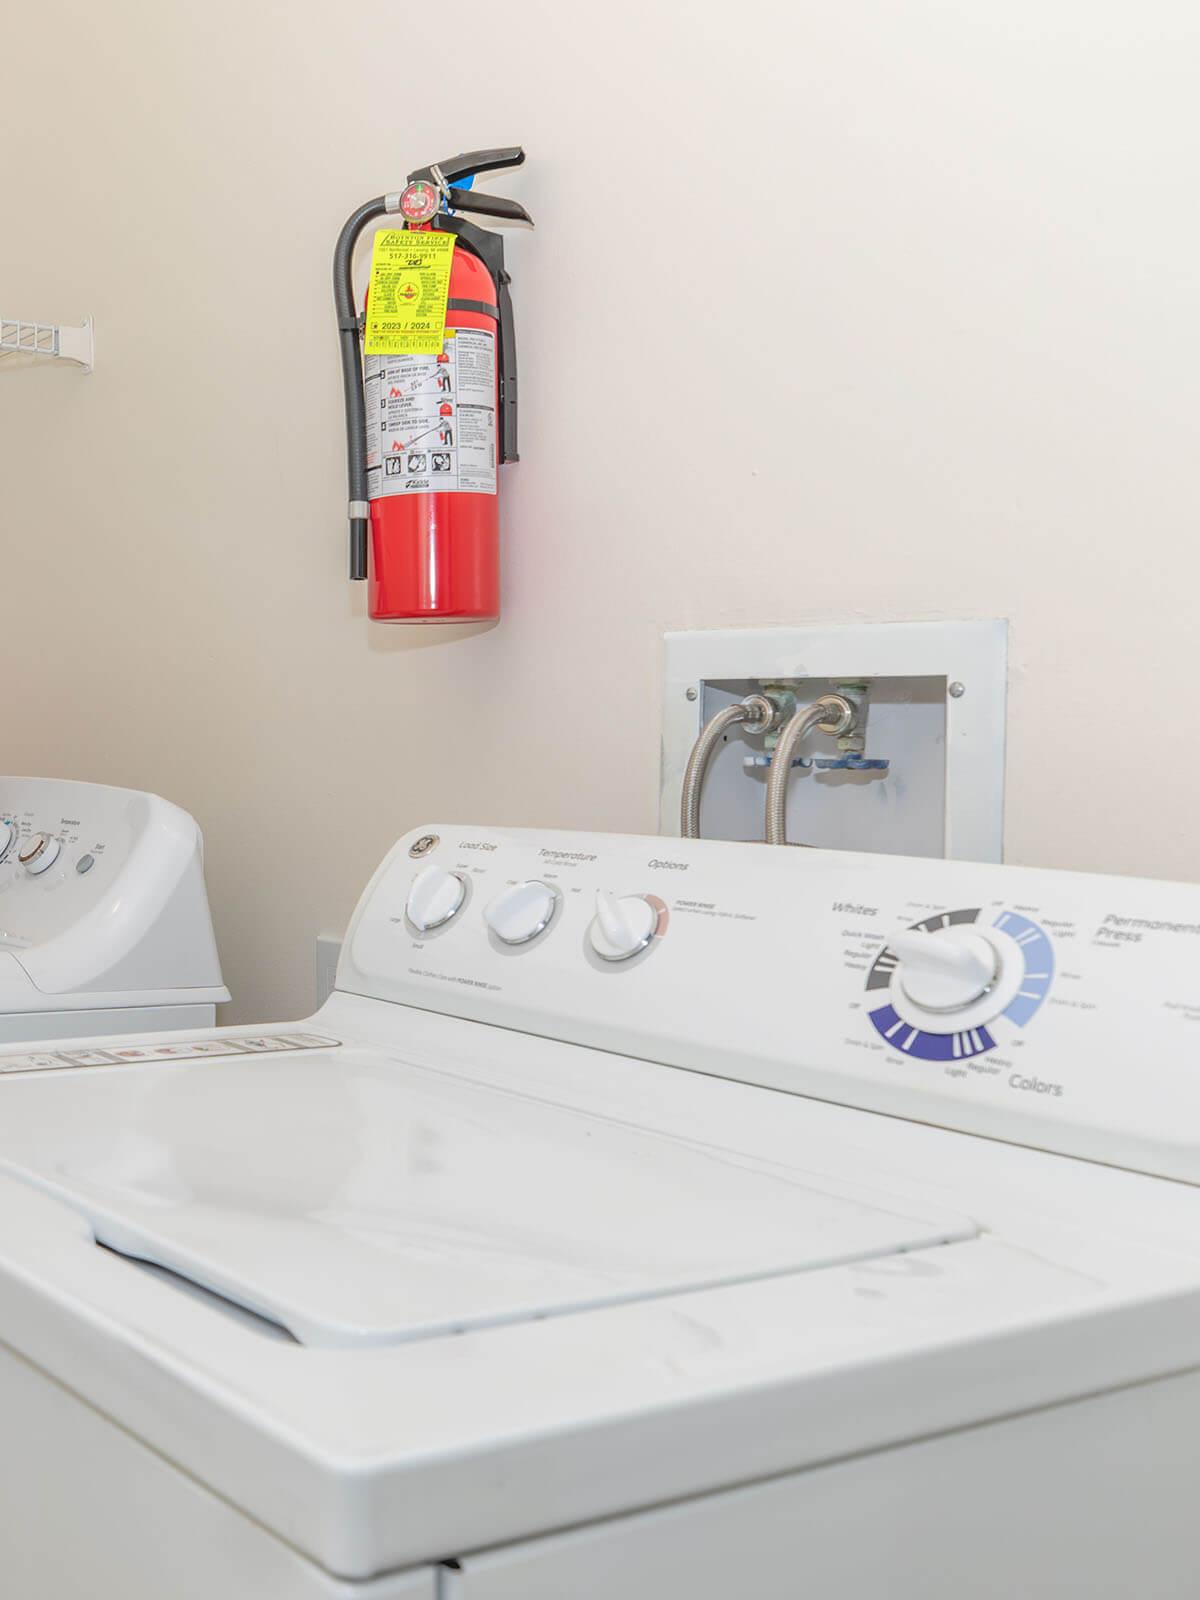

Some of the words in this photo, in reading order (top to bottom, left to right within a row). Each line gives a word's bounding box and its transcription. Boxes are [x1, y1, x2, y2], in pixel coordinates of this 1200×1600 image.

[381, 321, 401, 329] 2023
[410, 321, 430, 330] 2024
[458, 840, 481, 850] Load
[481, 842, 498, 853] Size
[537, 848, 598, 862] Temperature
[647, 858, 690, 872] Options
[832, 901, 879, 917] Whites
[1095, 926, 1144, 943] Press
[843, 949, 873, 959] Regular
[944, 1066, 969, 1078] Light
[967, 1061, 1001, 1075] Regular
[1008, 1074, 1063, 1096] Colors
